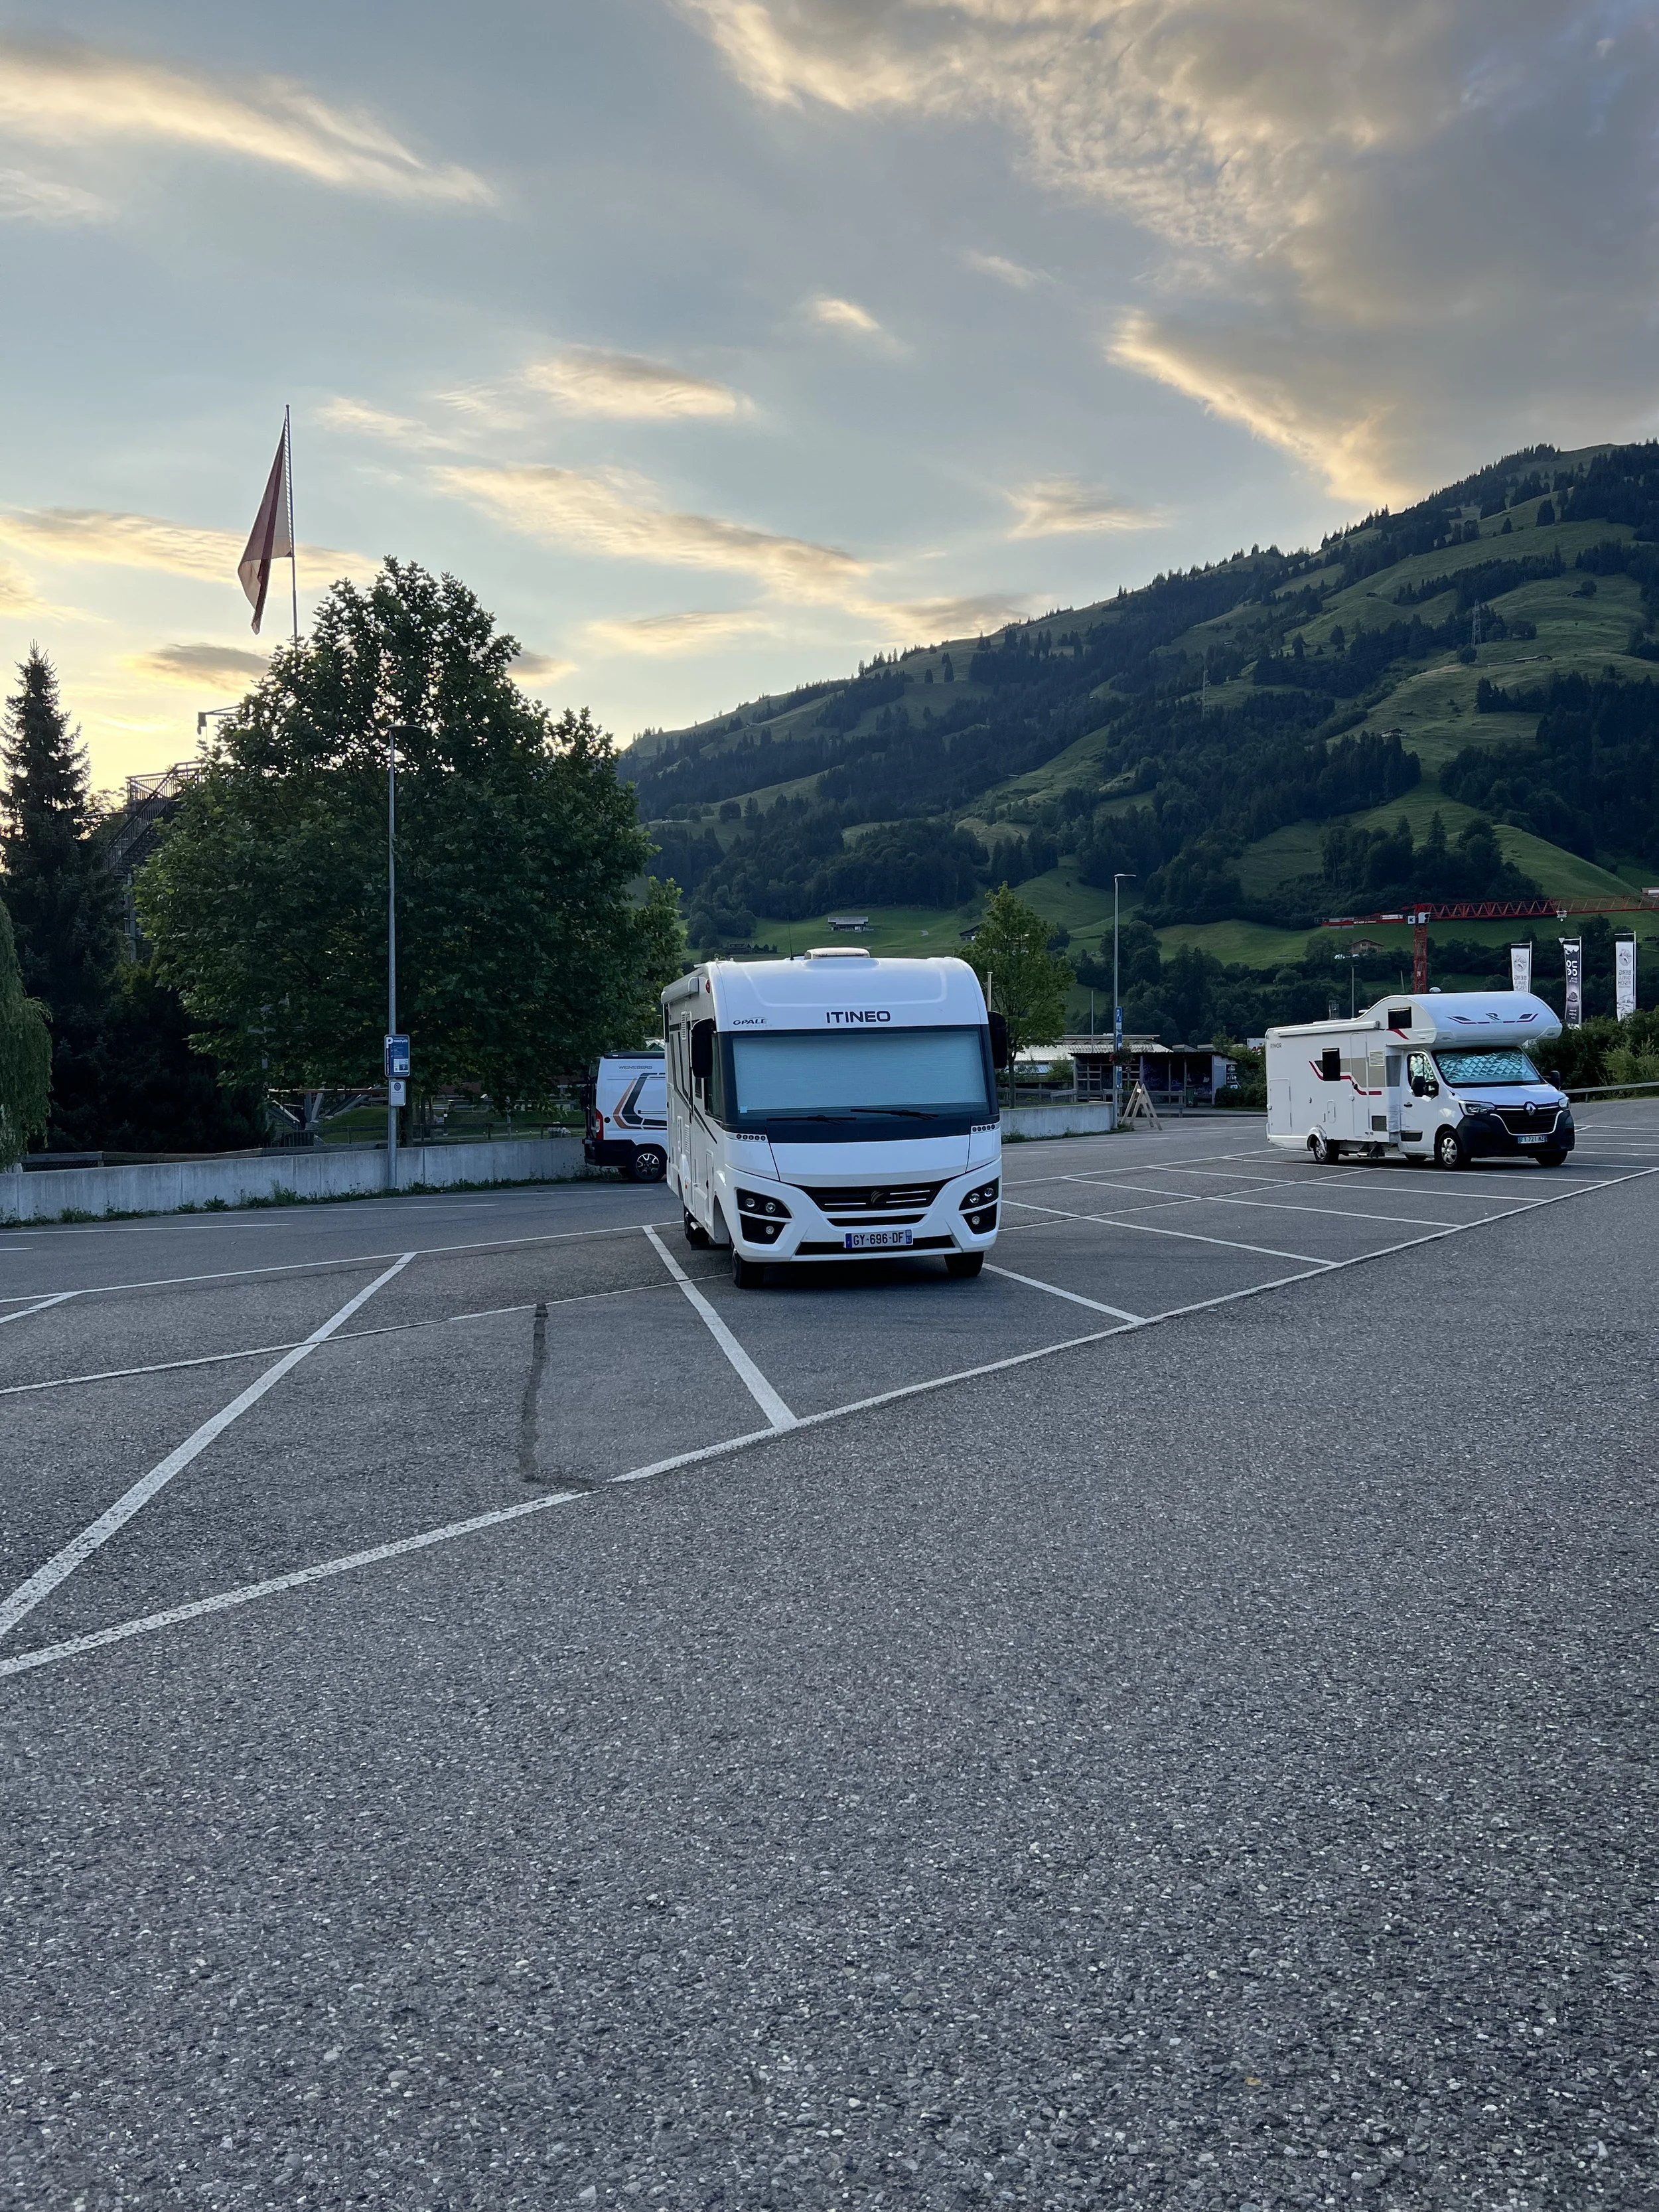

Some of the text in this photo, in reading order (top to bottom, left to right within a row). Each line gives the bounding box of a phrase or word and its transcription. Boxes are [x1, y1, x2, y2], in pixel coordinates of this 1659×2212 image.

[826, 1011, 891, 1023] ITINEO
[386, 1037, 394, 1049] P
[853, 1232, 904, 1246] GY-696-DF
